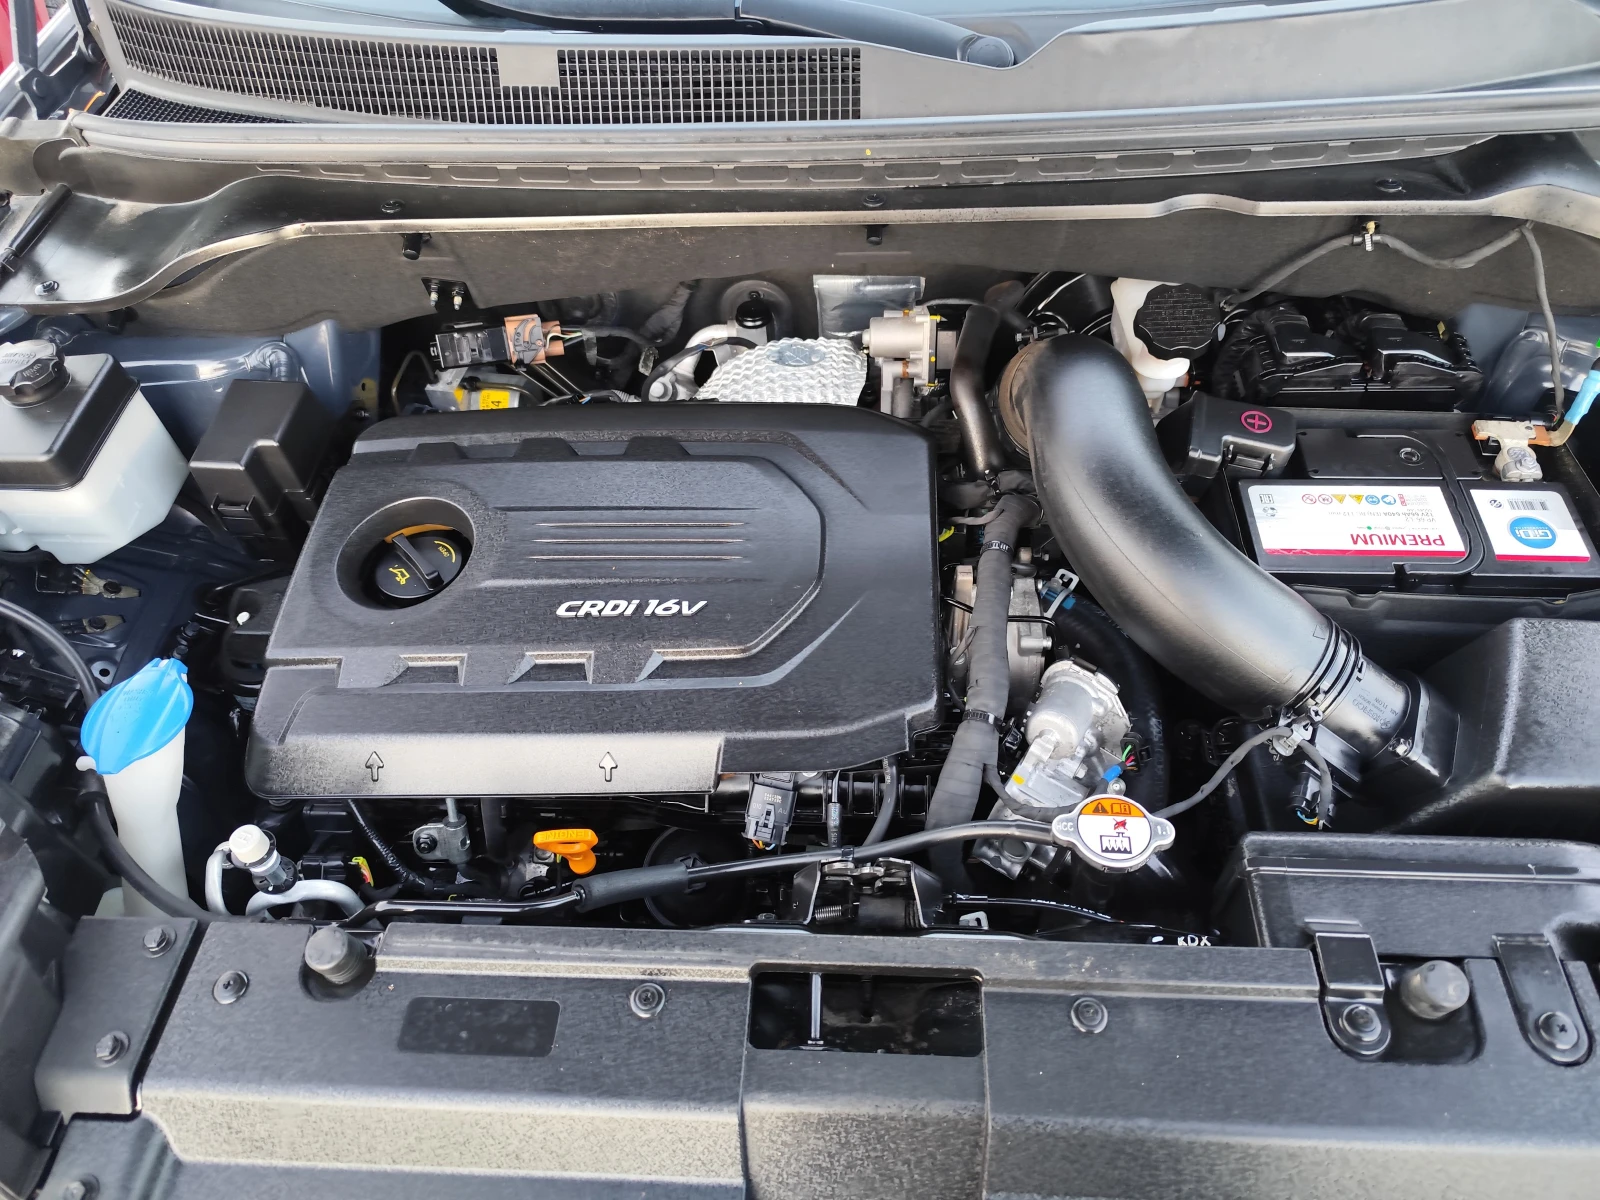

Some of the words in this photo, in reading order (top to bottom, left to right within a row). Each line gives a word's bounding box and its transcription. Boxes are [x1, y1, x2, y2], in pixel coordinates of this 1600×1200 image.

[1350, 533, 1446, 546] PREMIUM
[555, 599, 641, 618] CRDi
[643, 598, 708, 617] 16V
[1056, 822, 1074, 832] HCC
[1156, 825, 1171, 835] 1.1
